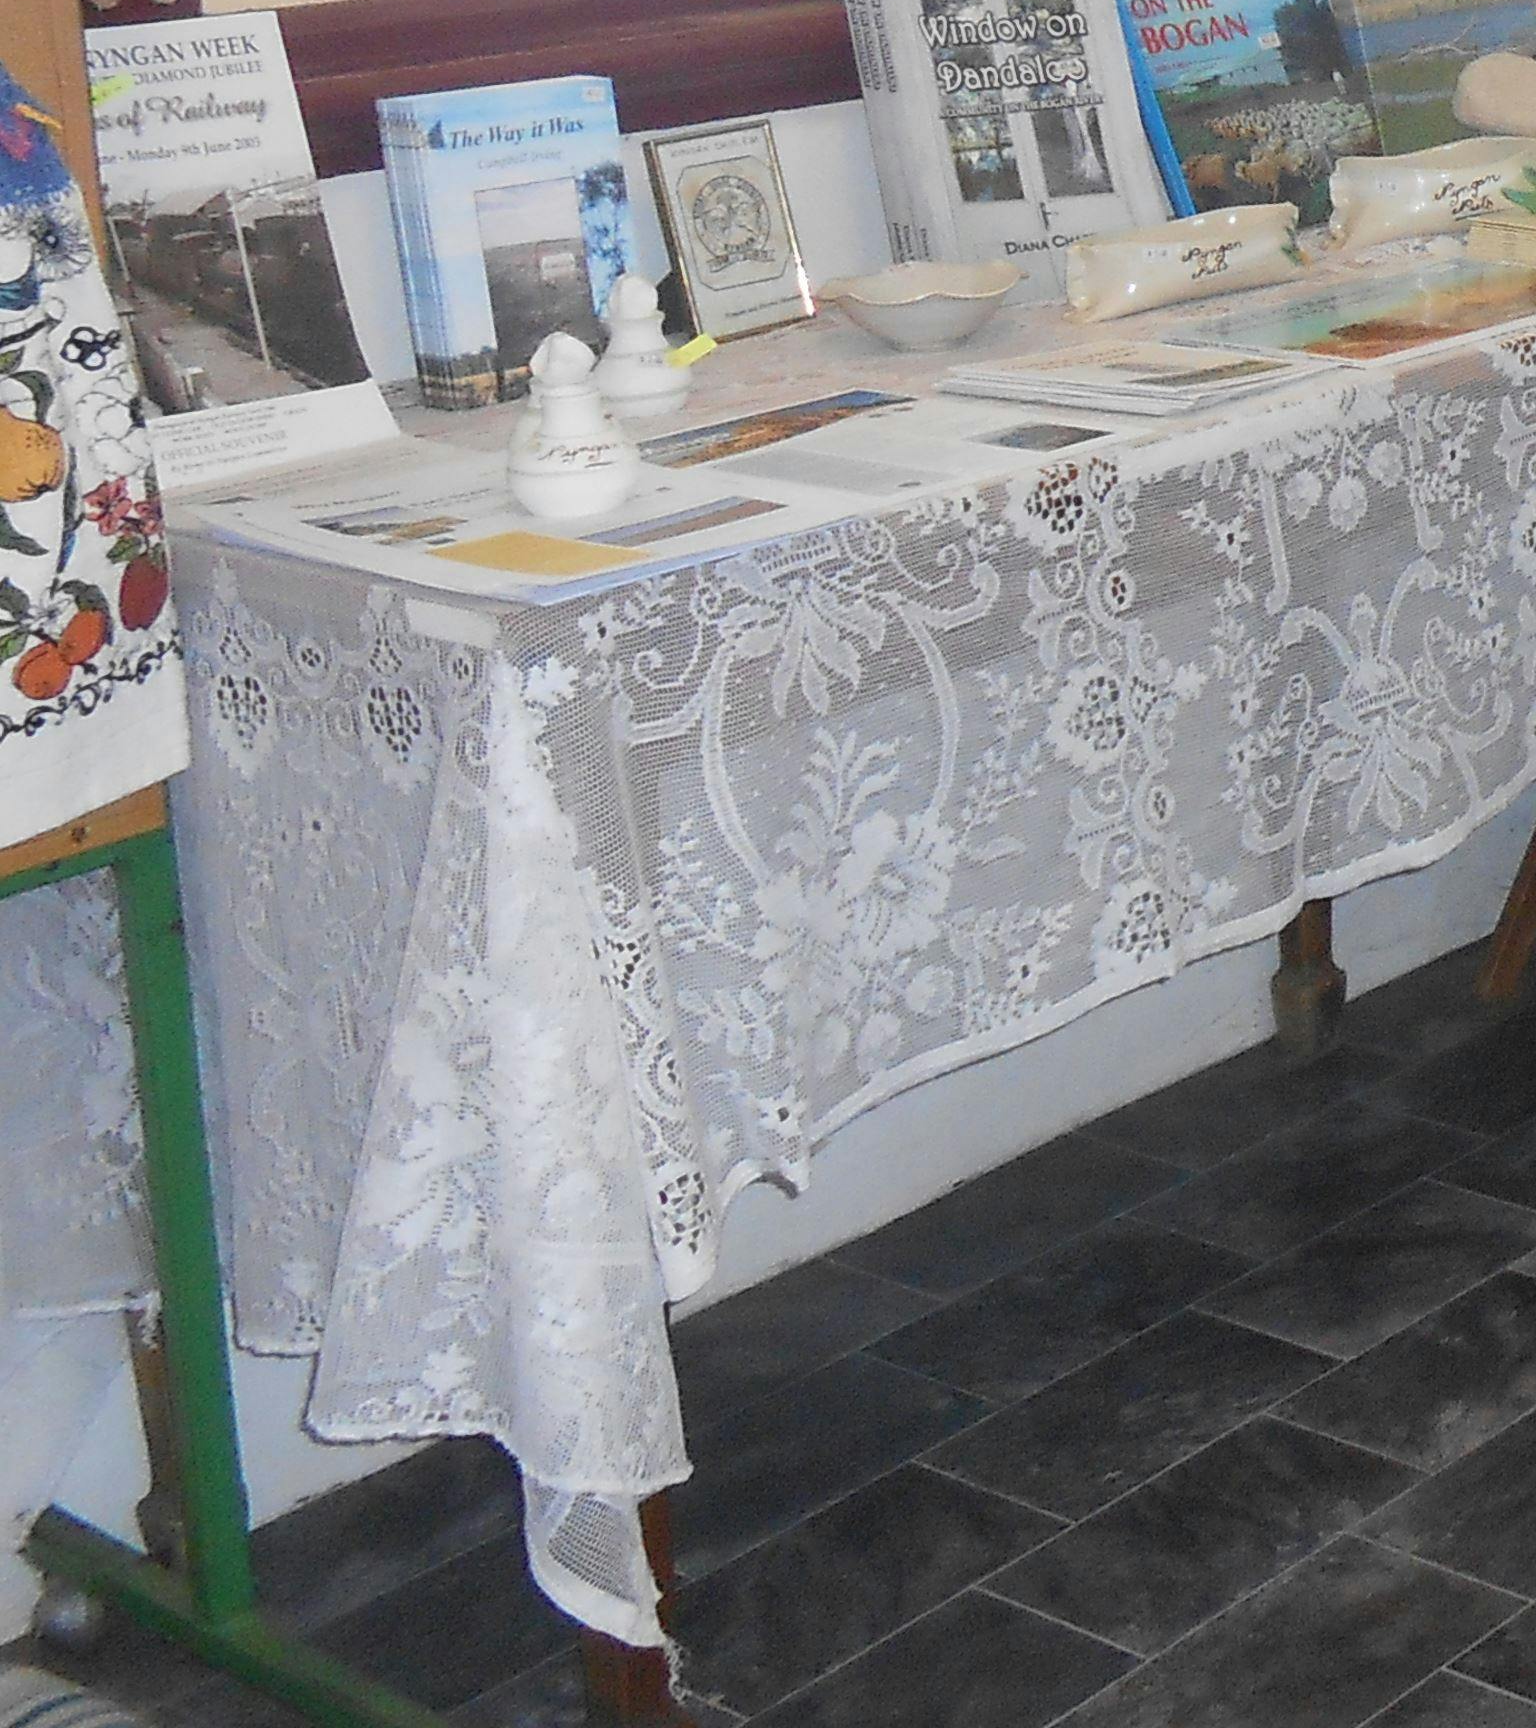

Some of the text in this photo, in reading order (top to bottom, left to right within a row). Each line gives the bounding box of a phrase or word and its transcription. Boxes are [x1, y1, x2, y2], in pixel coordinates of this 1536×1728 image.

[918, 11, 1088, 48] Window on
[1140, 13, 1249, 54] BOGAN
[191, 34, 260, 58] WEEK
[146, 93, 269, 124] Railway
[203, 141, 231, 156] June
[451, 117, 584, 150] The Way it Was
[1005, 239, 1050, 256] DIANA
